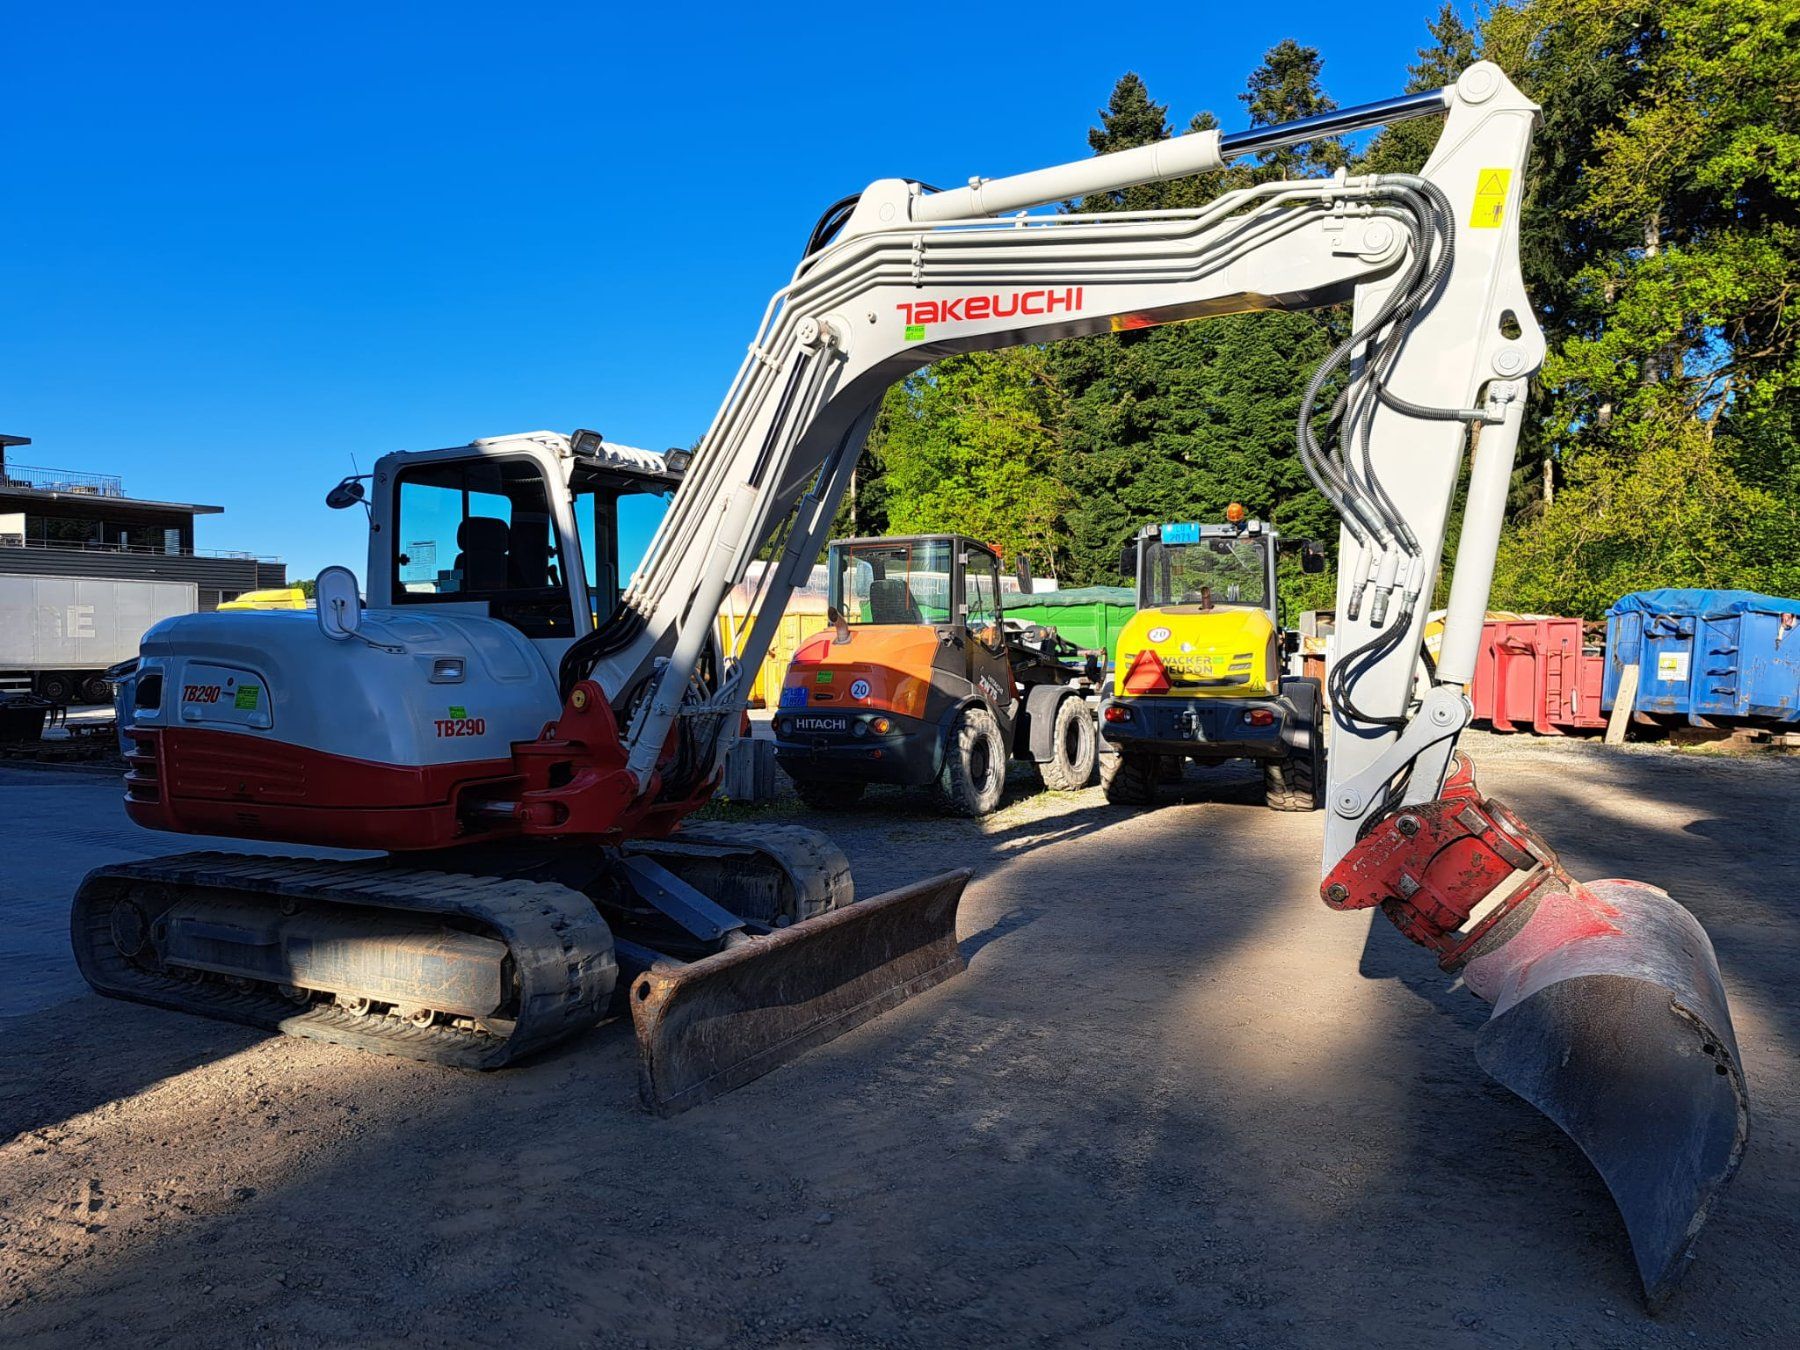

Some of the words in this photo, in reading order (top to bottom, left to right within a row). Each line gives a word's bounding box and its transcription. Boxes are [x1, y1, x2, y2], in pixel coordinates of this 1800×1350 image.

[1160, 656, 1213, 666] WACKER
[183, 685, 221, 703] TB290
[853, 684, 868, 697] 20
[434, 718, 486, 737] TB290
[796, 719, 846, 730] HITACHI
